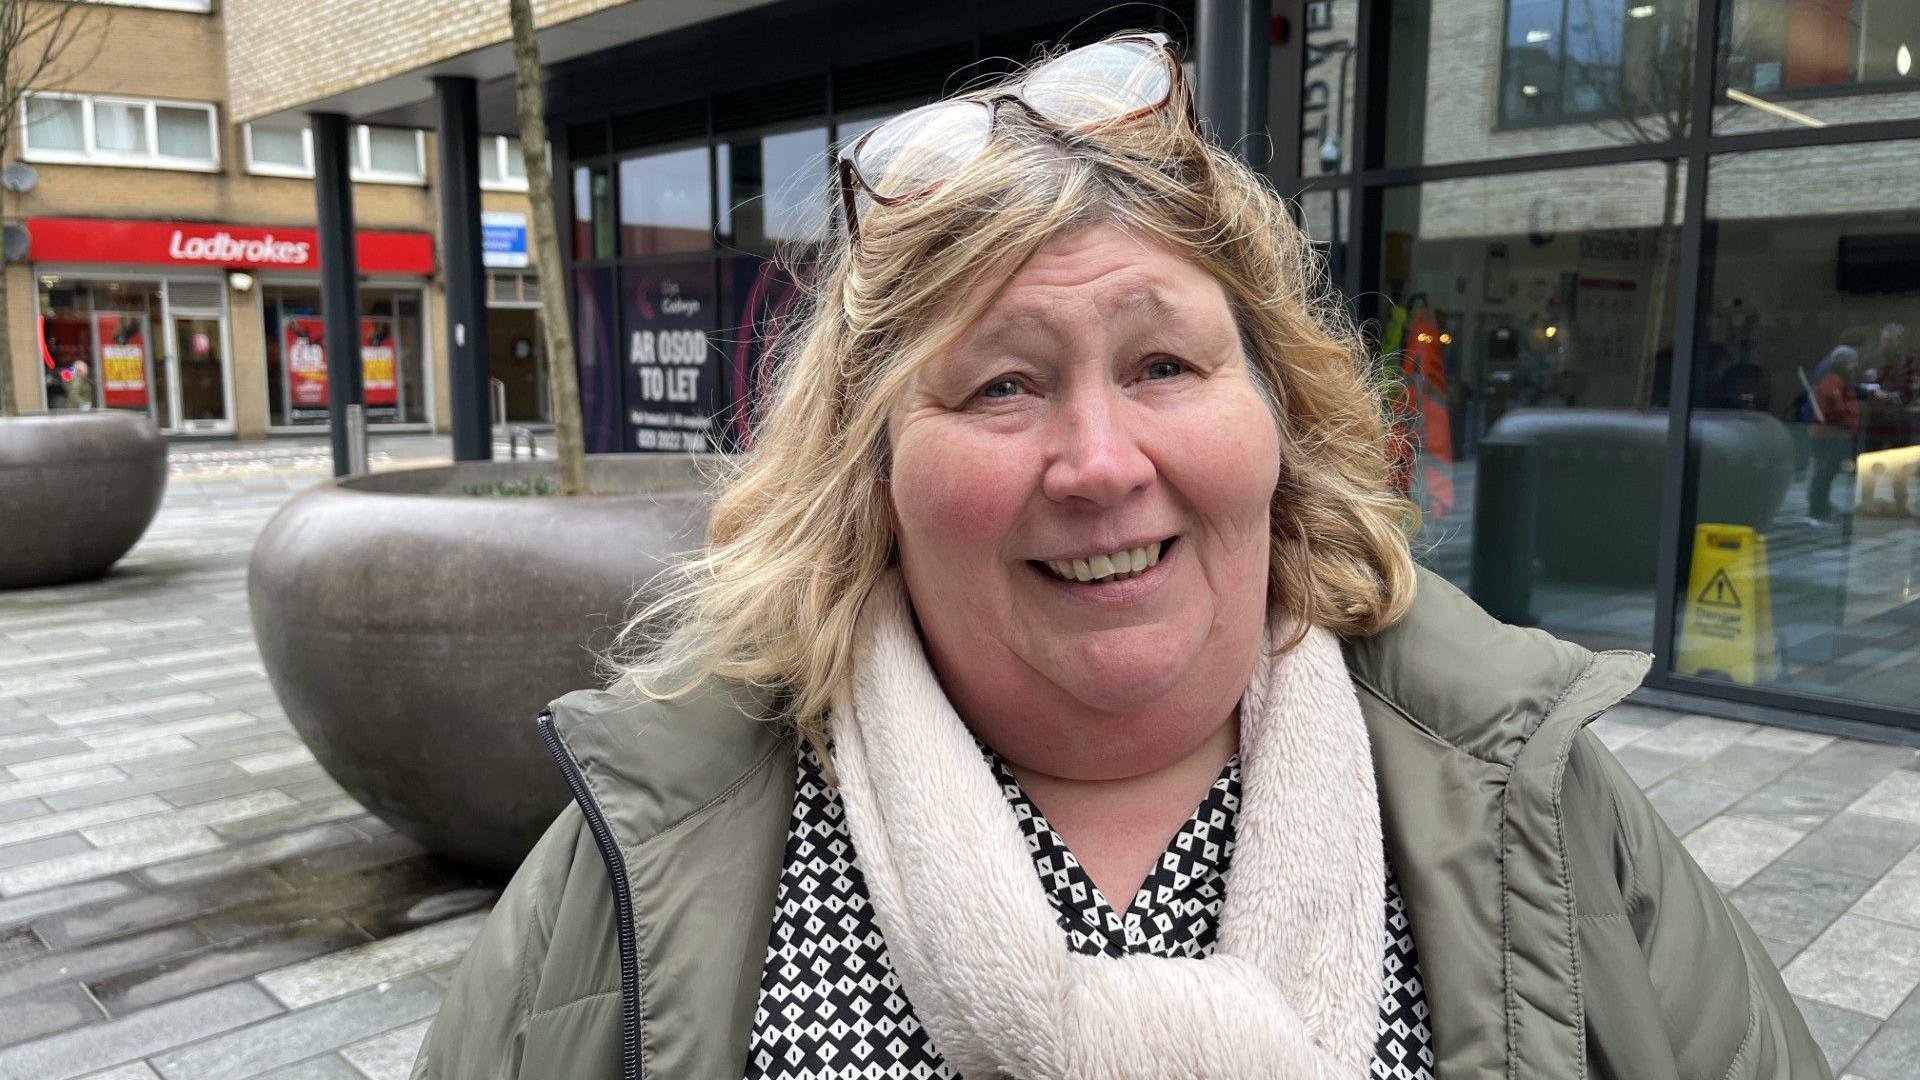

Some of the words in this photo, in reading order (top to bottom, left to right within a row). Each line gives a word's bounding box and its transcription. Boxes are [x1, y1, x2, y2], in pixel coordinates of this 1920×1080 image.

[169, 230, 310, 264] Ladbrokes
[630, 329, 656, 364] AR
[658, 329, 707, 364] OSOD
[639, 366, 665, 401] TO
[667, 367, 700, 402] LET
